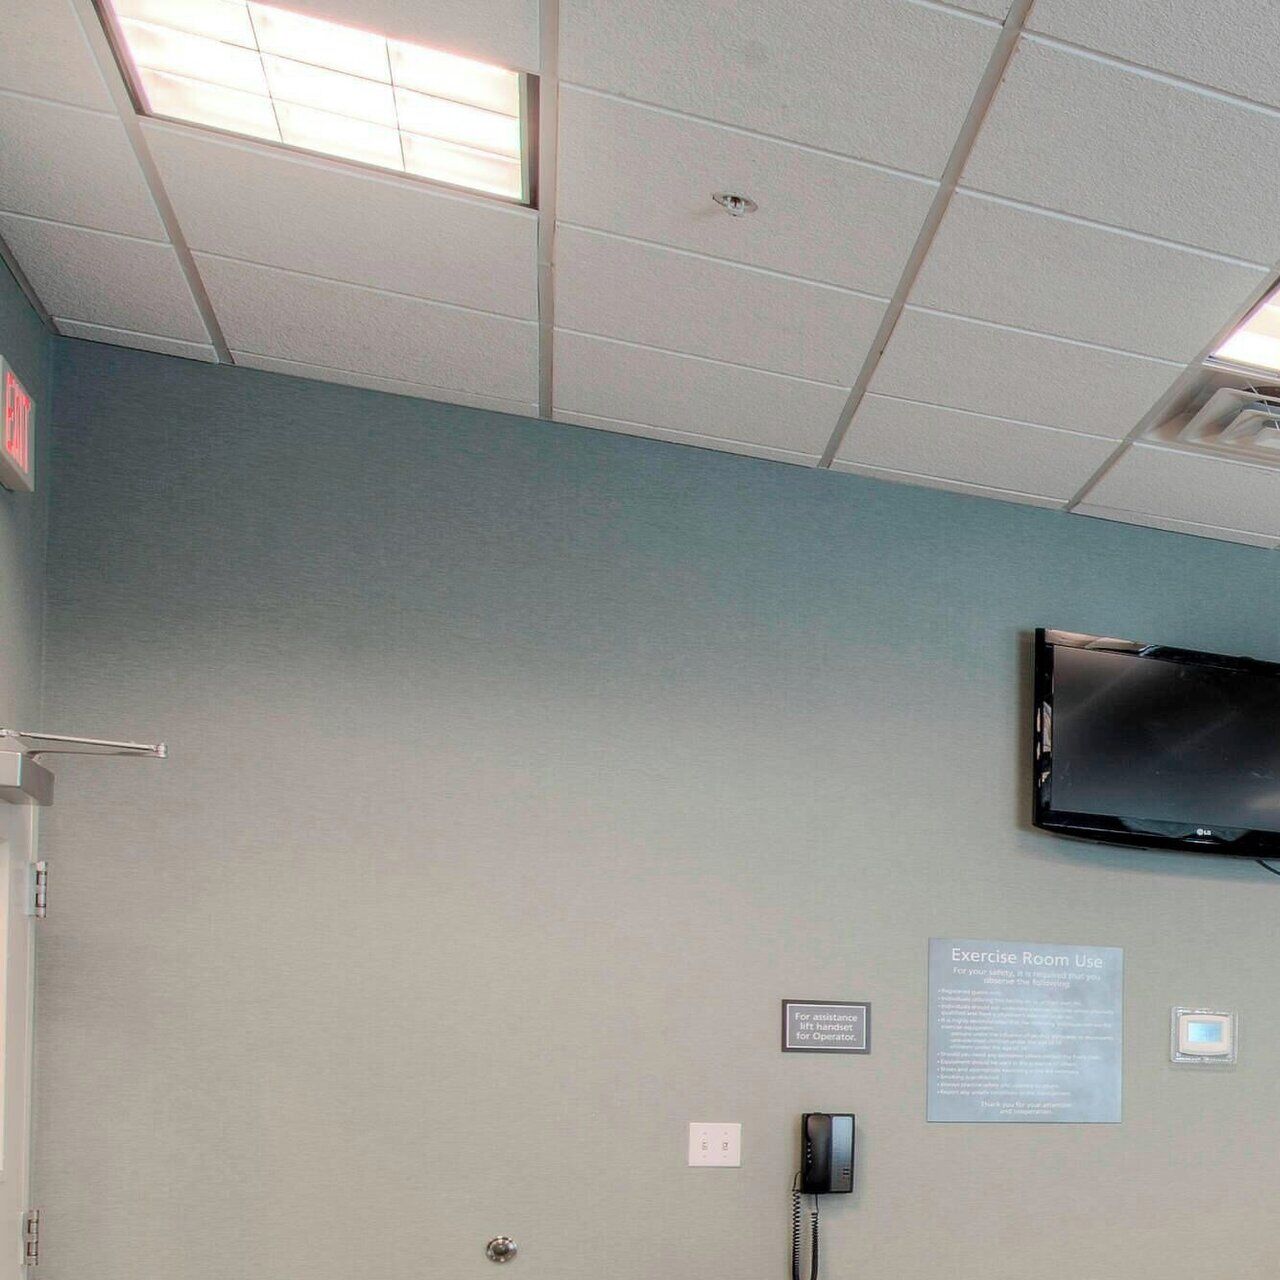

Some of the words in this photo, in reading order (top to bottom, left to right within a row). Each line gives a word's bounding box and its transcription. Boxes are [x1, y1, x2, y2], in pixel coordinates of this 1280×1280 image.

[5, 370, 31, 475] EXIT
[952, 948, 1017, 964] Exercise
[1022, 951, 1069, 966] Room
[1075, 954, 1103, 968] Use
[795, 1012, 811, 1020] For
[813, 1013, 857, 1022] assistance
[800, 1022, 814, 1031] lift
[816, 1022, 853, 1031] handset
[796, 1032, 810, 1040] for
[813, 1032, 856, 1042] Operator.
